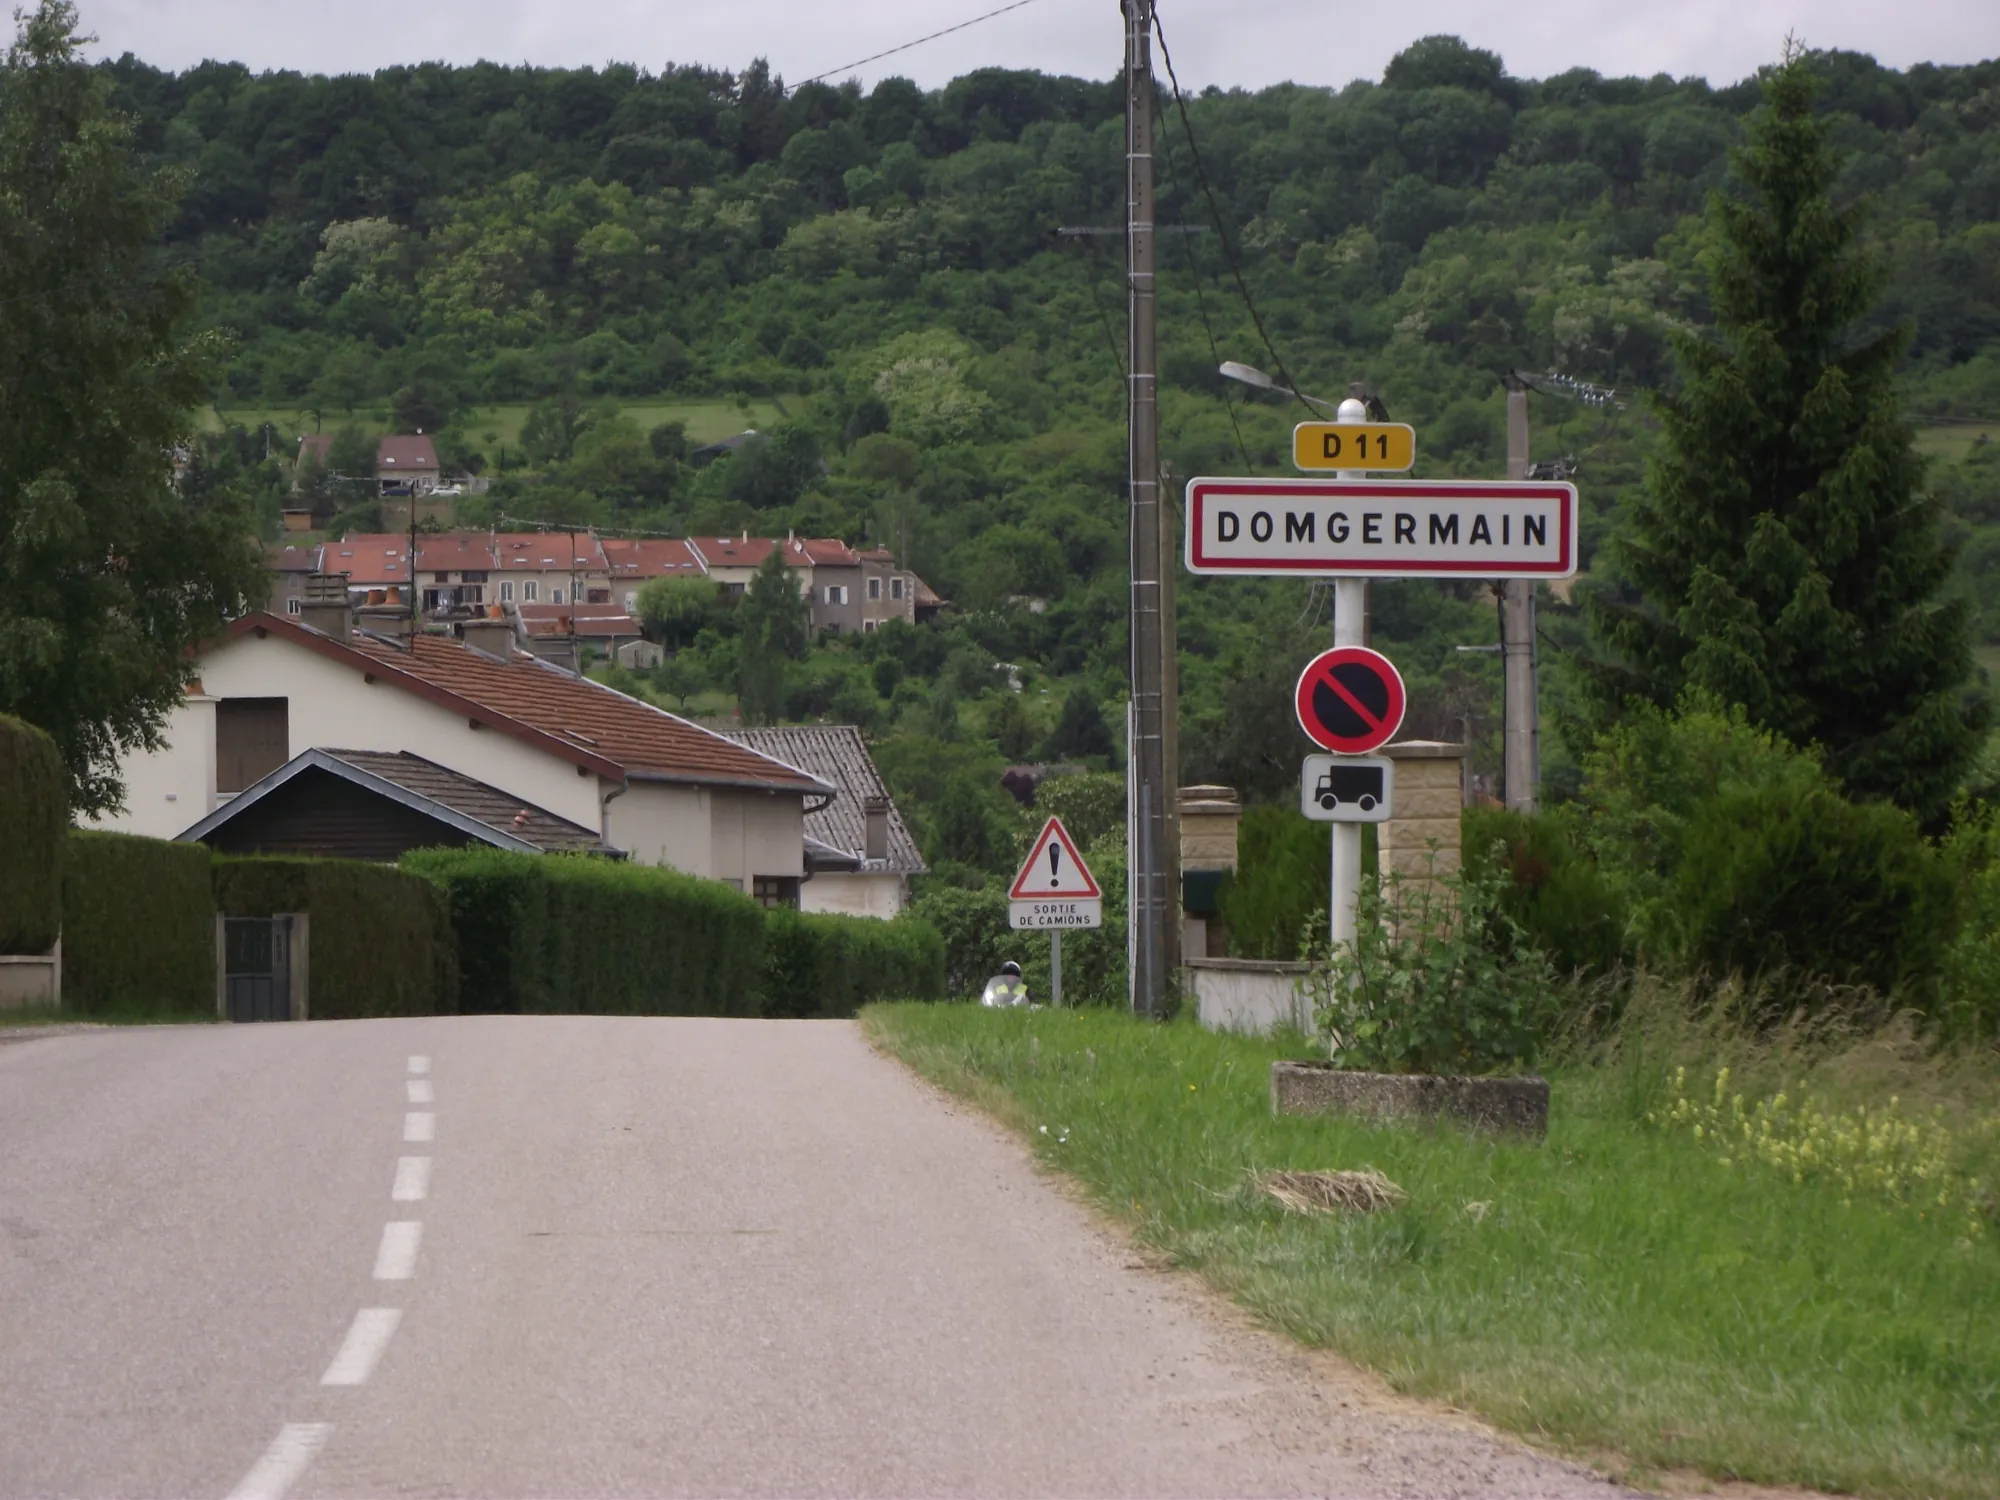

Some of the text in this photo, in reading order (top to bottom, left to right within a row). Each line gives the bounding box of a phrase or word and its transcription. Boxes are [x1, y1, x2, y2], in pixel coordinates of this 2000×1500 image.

[1323, 433, 1388, 459] D 11
[1217, 510, 1547, 546] DOMGERMAIN
[1034, 904, 1076, 914] SORTIE
[1019, 915, 1090, 926] DE CAMIONS
